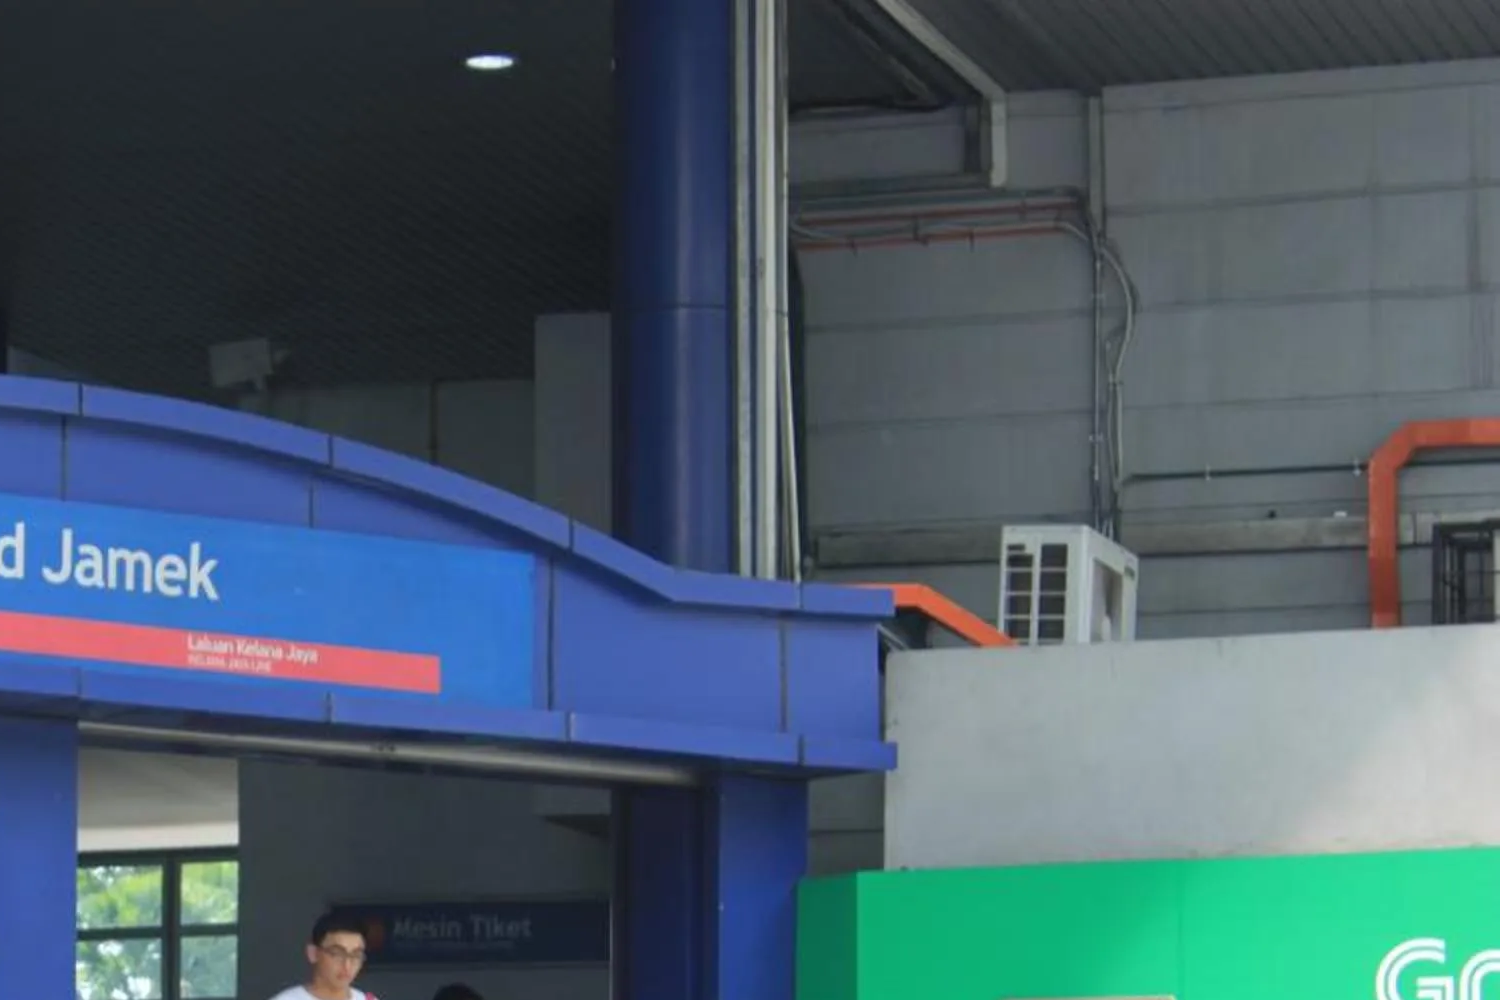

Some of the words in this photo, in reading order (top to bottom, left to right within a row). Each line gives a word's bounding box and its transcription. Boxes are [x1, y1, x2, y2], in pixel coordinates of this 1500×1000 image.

[41, 527, 220, 602] Jamek
[394, 914, 462, 939] Mesin
[469, 913, 533, 939] Tiket
